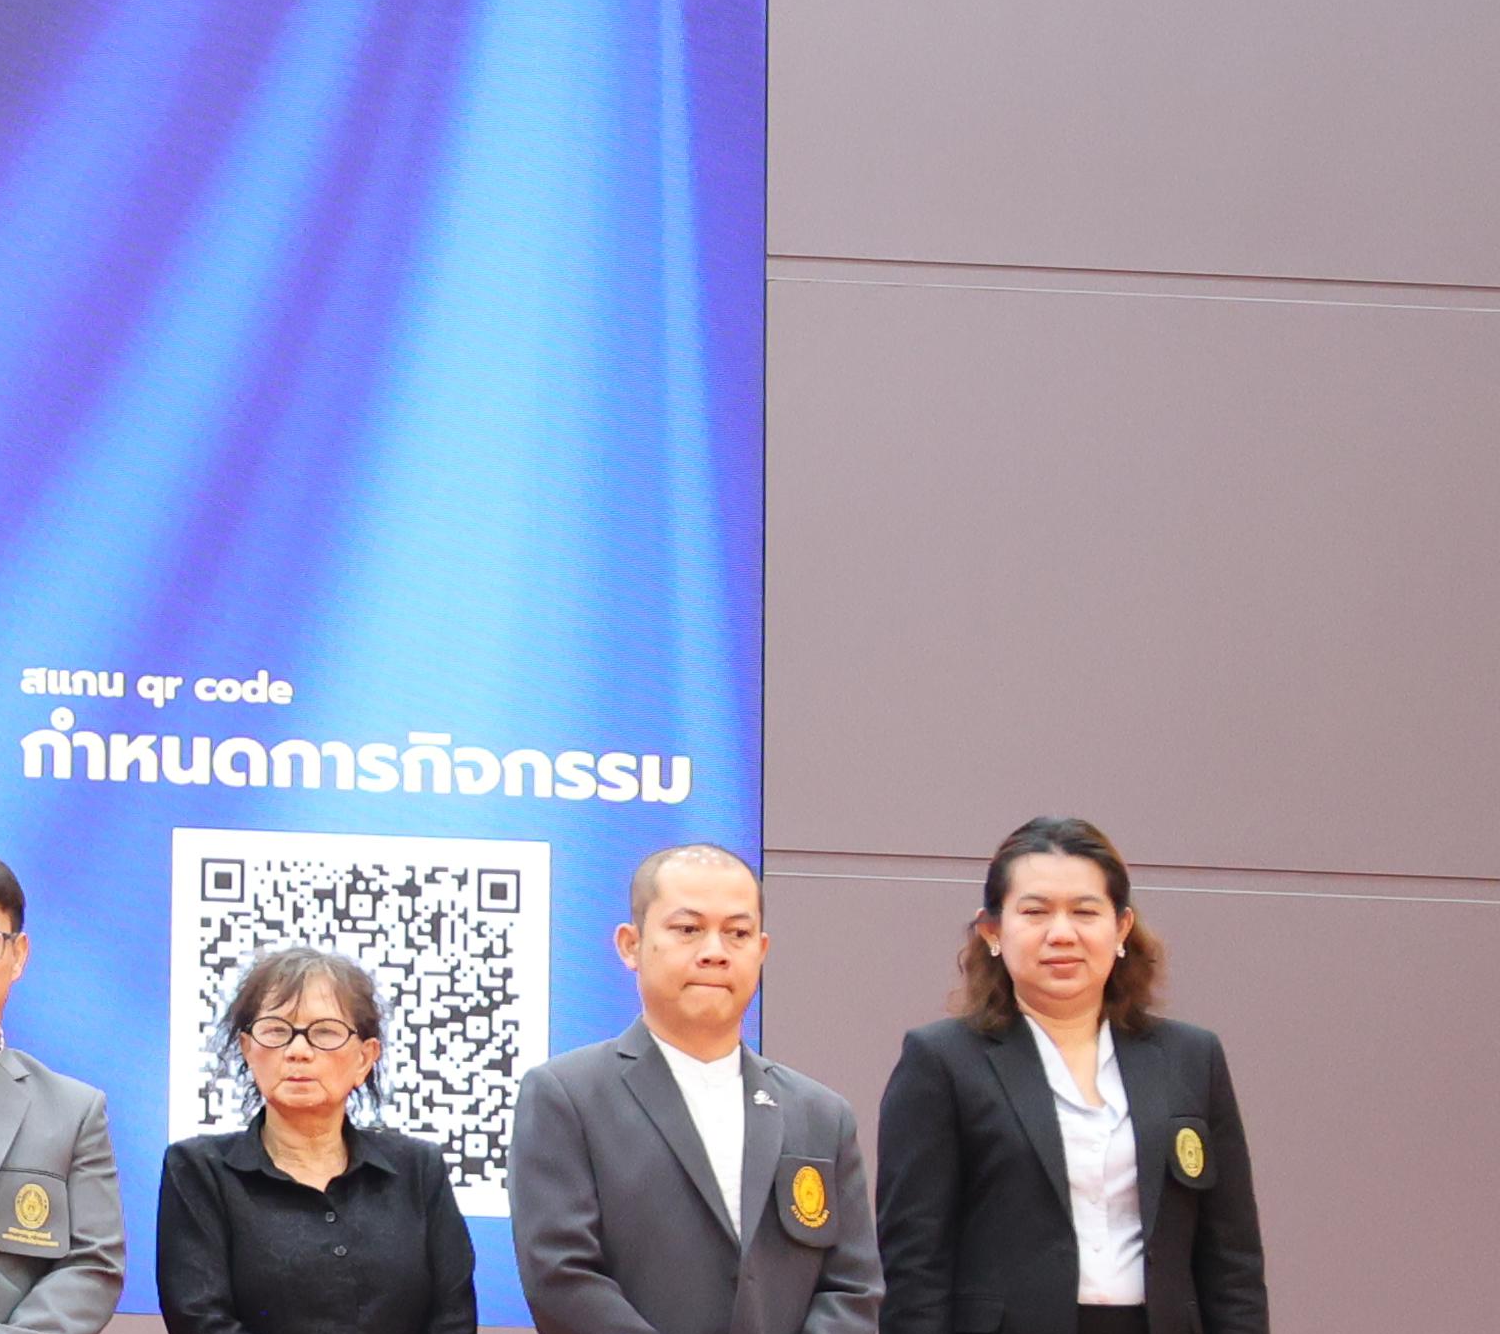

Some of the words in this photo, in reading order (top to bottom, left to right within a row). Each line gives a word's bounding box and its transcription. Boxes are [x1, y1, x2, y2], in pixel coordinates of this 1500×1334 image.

[20, 666, 124, 698] สแกน
[136, 670, 183, 708] qr
[194, 670, 294, 705] code
[19, 707, 693, 806] กำหนดการกิจกรรม
